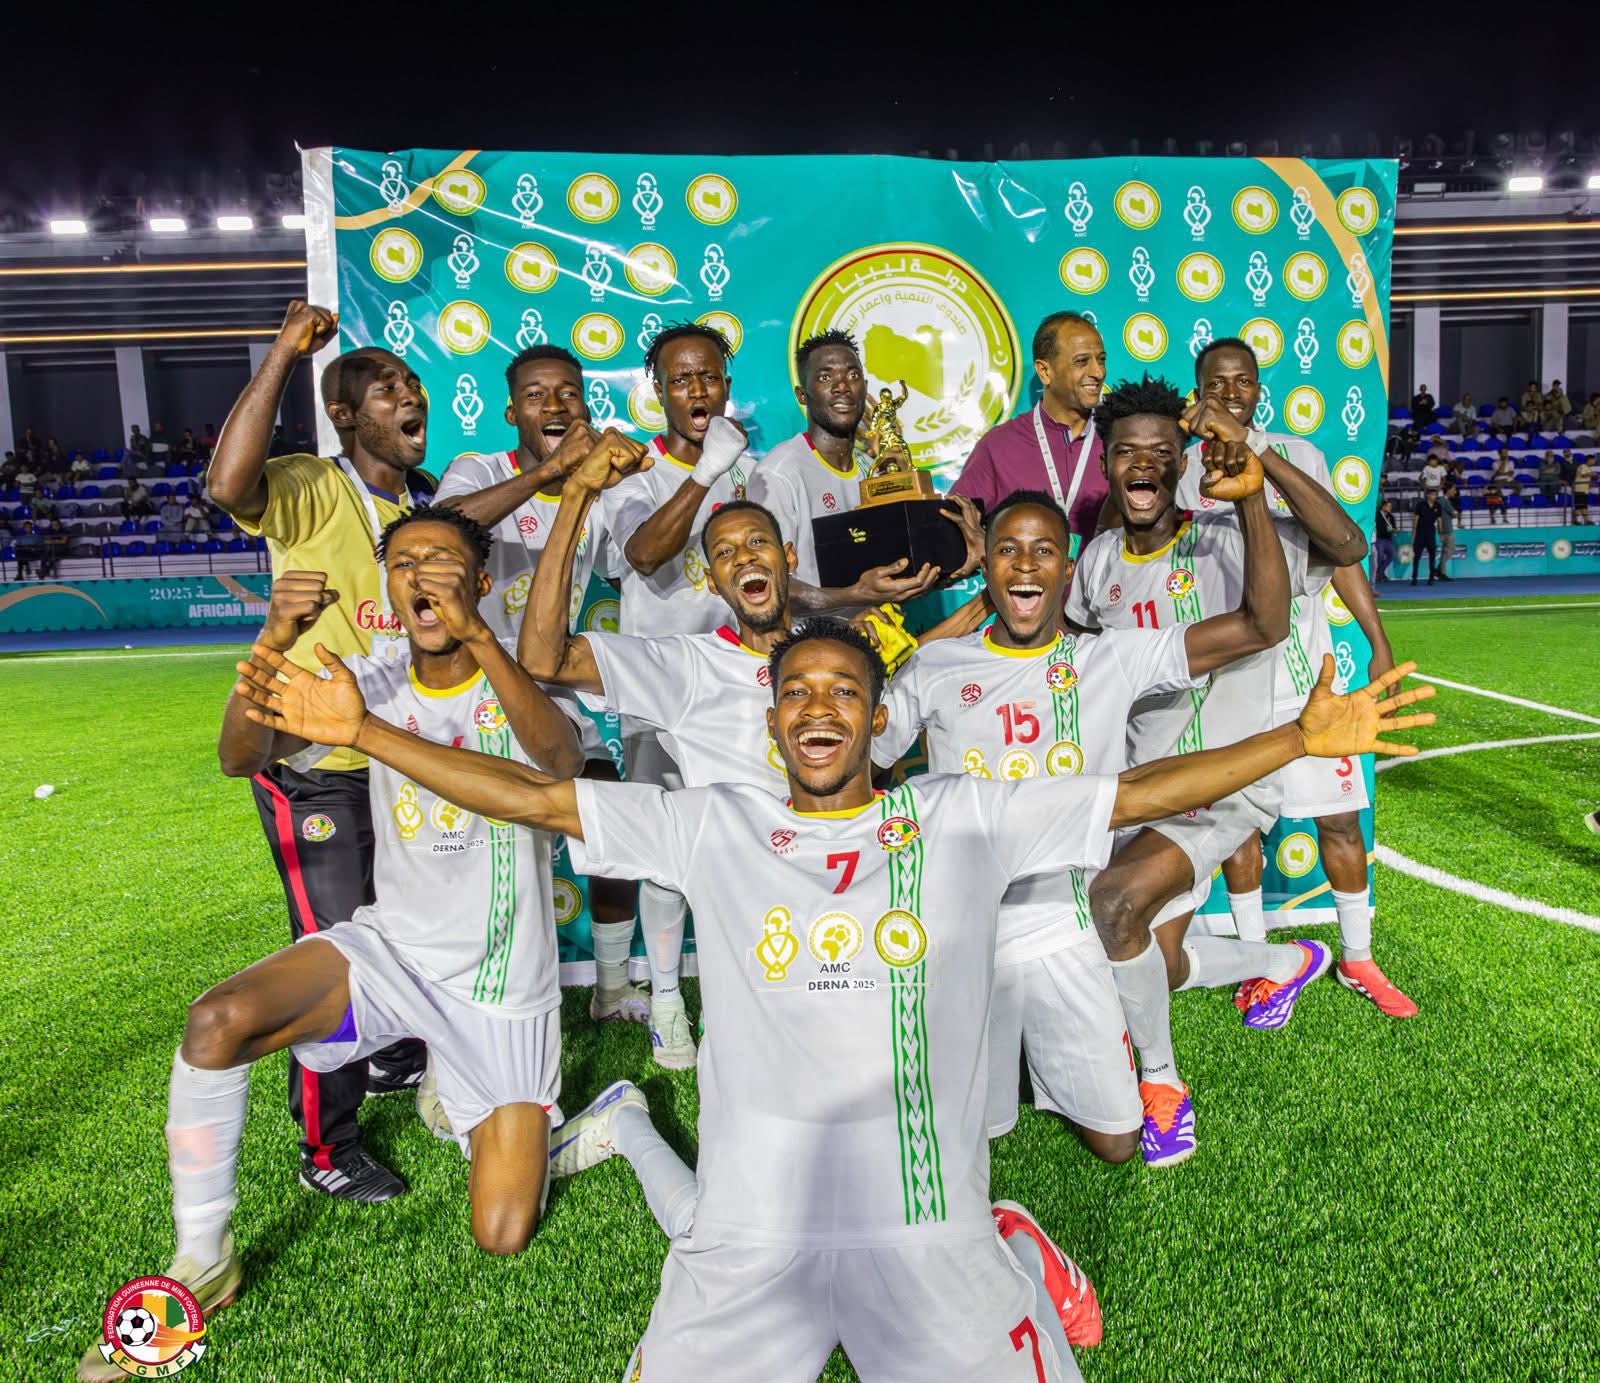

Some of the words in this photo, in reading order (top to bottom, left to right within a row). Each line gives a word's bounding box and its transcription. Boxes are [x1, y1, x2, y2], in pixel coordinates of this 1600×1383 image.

[150, 587, 193, 601] 2025
[189, 603, 241, 618] AFRICAN
[1132, 600, 1160, 629] 11
[996, 701, 1041, 746] 15
[442, 831, 465, 839] AMC
[433, 844, 465, 852] DERNA
[826, 850, 860, 894] 7
[820, 962, 851, 973] AMC
[808, 980, 850, 991] DERNA
[853, 980, 875, 989] 2025
[1008, 1315, 1046, 1383] 7
